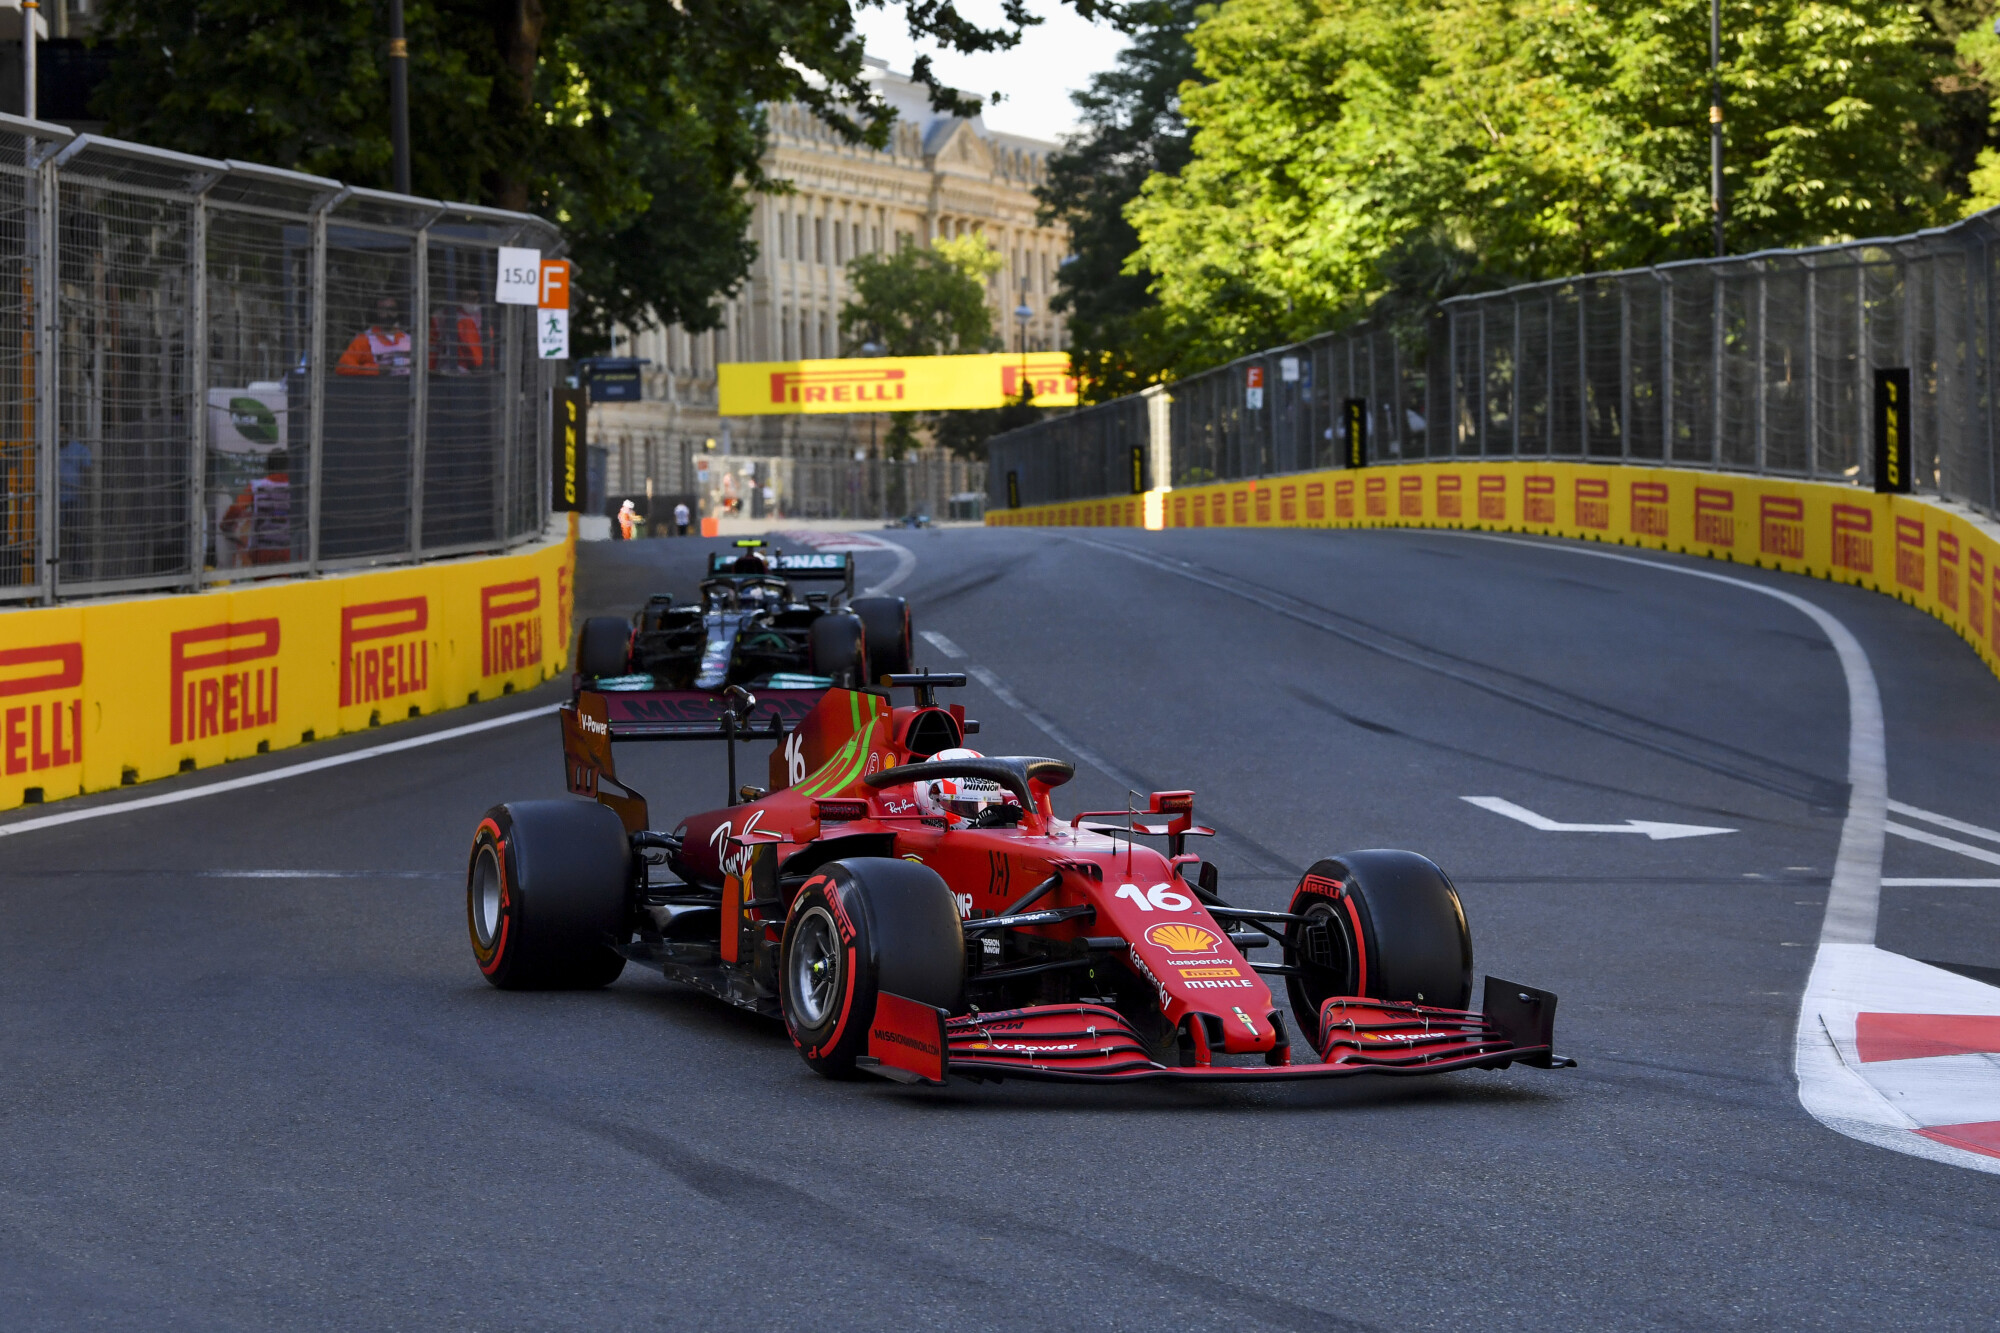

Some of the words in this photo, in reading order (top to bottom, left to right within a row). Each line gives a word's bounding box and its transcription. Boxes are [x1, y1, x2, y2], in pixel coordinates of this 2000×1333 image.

[503, 267, 537, 285] 15.0
[542, 266, 564, 304] F
[770, 368, 905, 404] PIRELLI
[1247, 367, 1260, 387] F
[1886, 380, 1898, 403] P
[565, 400, 576, 422] P
[1886, 406, 1898, 486] ZERO
[565, 425, 576, 504] ZERO
[1760, 494, 1804, 560] PIRELLI
[481, 576, 542, 678] PIRELLI
[339, 595, 428, 708] PIRELLI
[170, 617, 281, 745] PIRELLI
[0, 642, 83, 777] PELLI
[622, 699, 820, 720] MISSON
[581, 713, 608, 735] V-Power
[784, 732, 806, 787] 16
[884, 799, 915, 813] Ray-Ban
[1115, 882, 1192, 912] 16
[1302, 873, 1343, 900] PIRELLI
[823, 878, 857, 945] PIRELLI
[1166, 958, 1234, 967] kaspersky
[1187, 969, 1234, 978] PIRELLI
[1129, 943, 1173, 1011] kaspersky
[1184, 979, 1254, 990] MAHLE
[993, 1043, 1078, 1051] V-Power
[1376, 1032, 1447, 1042] V-Power
